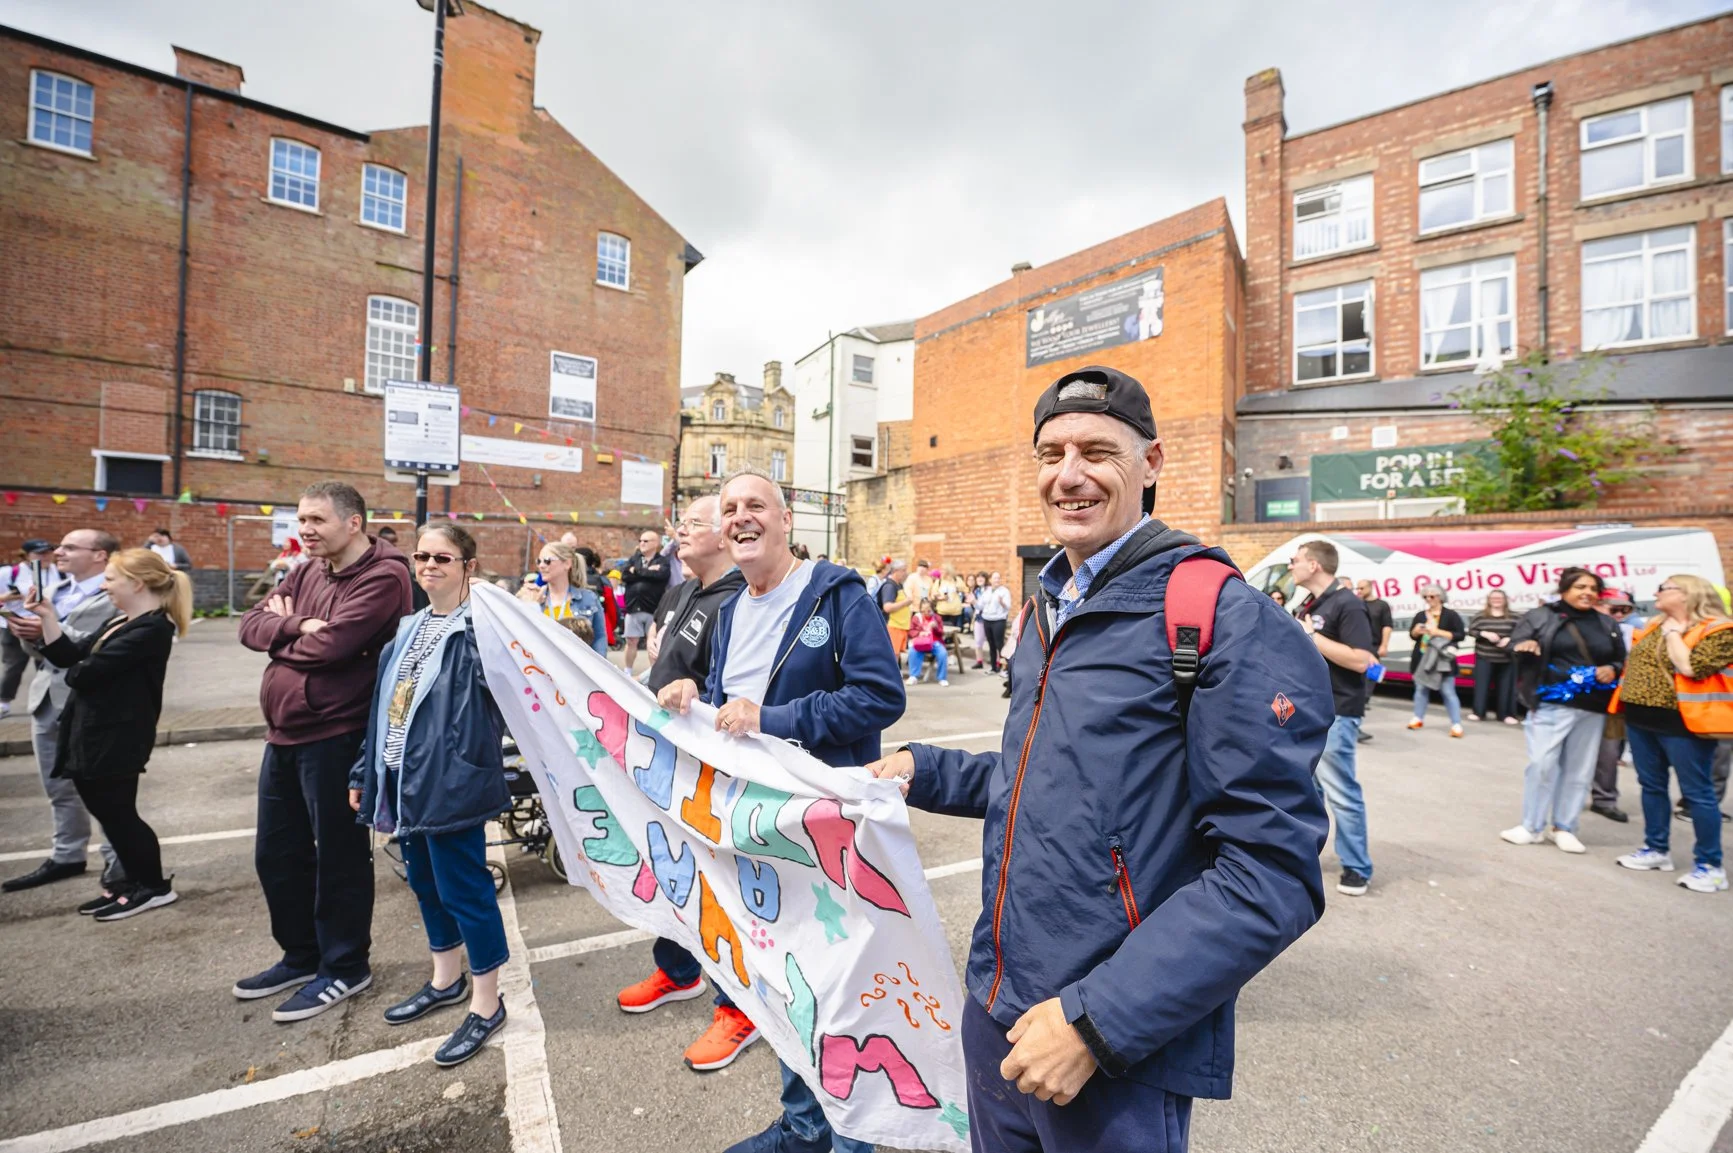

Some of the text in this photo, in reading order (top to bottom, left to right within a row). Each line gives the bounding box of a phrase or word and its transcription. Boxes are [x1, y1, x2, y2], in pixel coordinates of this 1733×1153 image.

[1376, 451, 1454, 472] POP IN
[1360, 472, 1404, 490] FOR
[1407, 471, 1425, 487] A
[1517, 555, 1630, 585] Visal
[1633, 565, 1657, 576] Ltd
[805, 626, 825, 636] S&B
